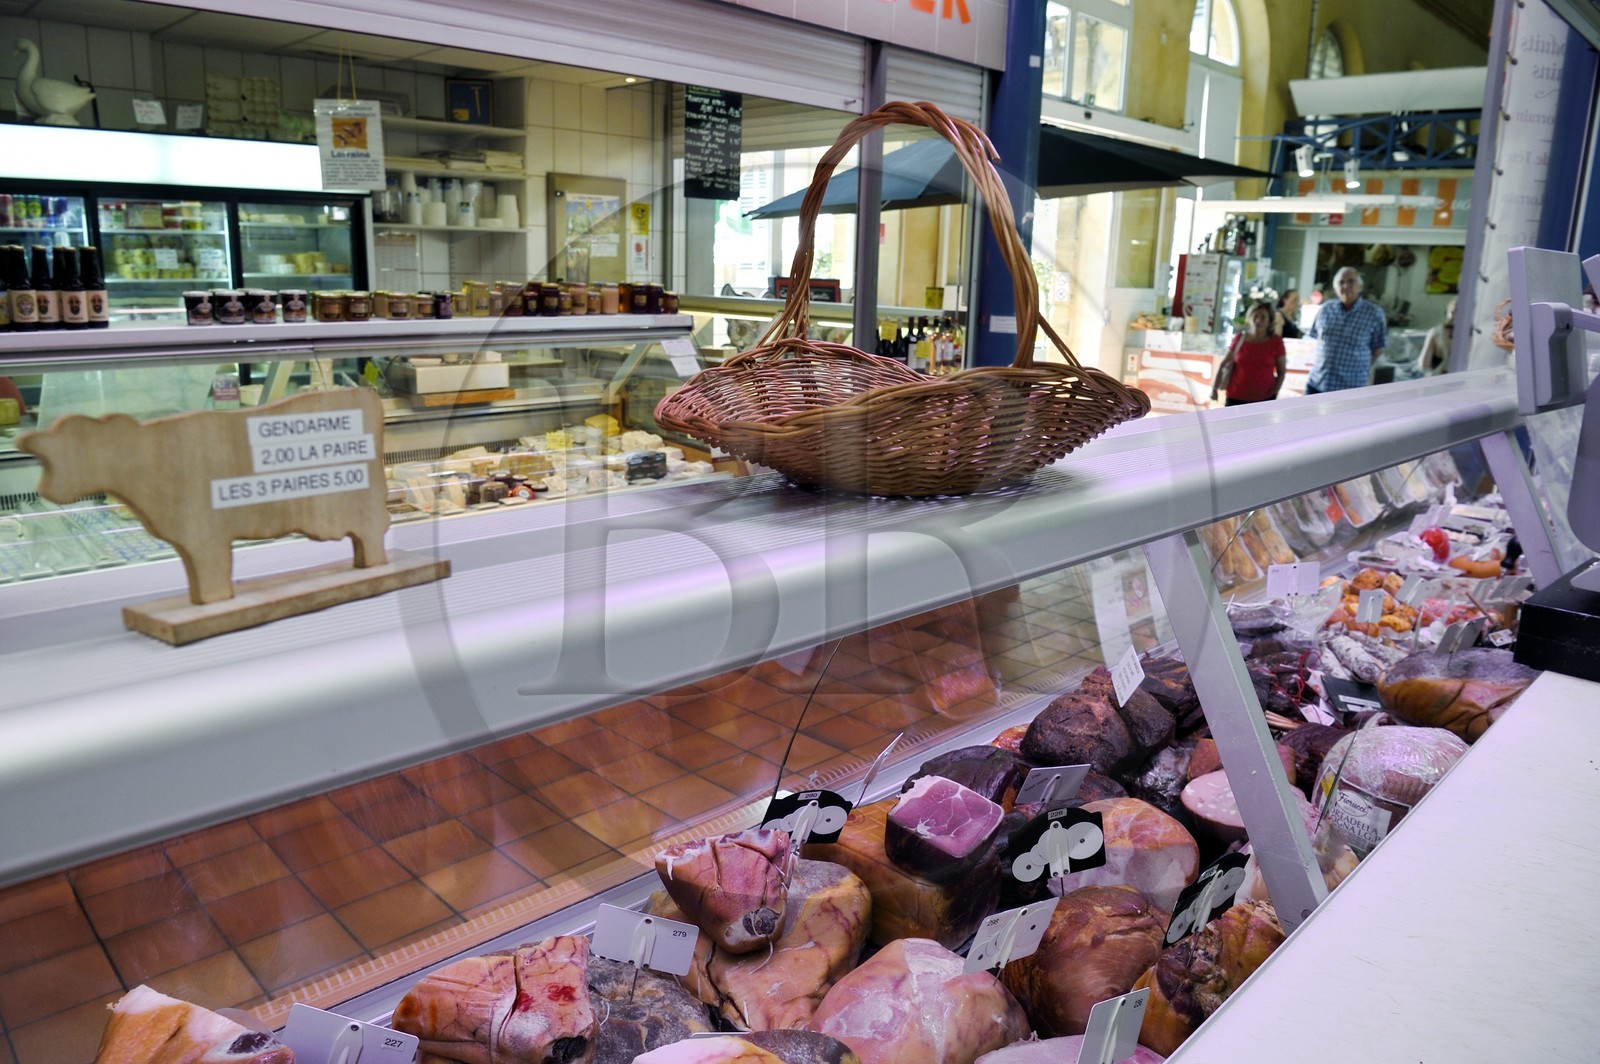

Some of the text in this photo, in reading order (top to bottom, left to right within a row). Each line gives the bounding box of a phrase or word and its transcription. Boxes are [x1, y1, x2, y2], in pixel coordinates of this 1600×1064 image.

[258, 415, 351, 438] GENDARME
[261, 440, 368, 466] 2,00 LA PAIRE
[218, 468, 364, 502] LES 3 PAIRES 5,00
[1338, 791, 1367, 813] Fiorucci
[672, 930, 687, 938] 279
[384, 1038, 403, 1049] 227
